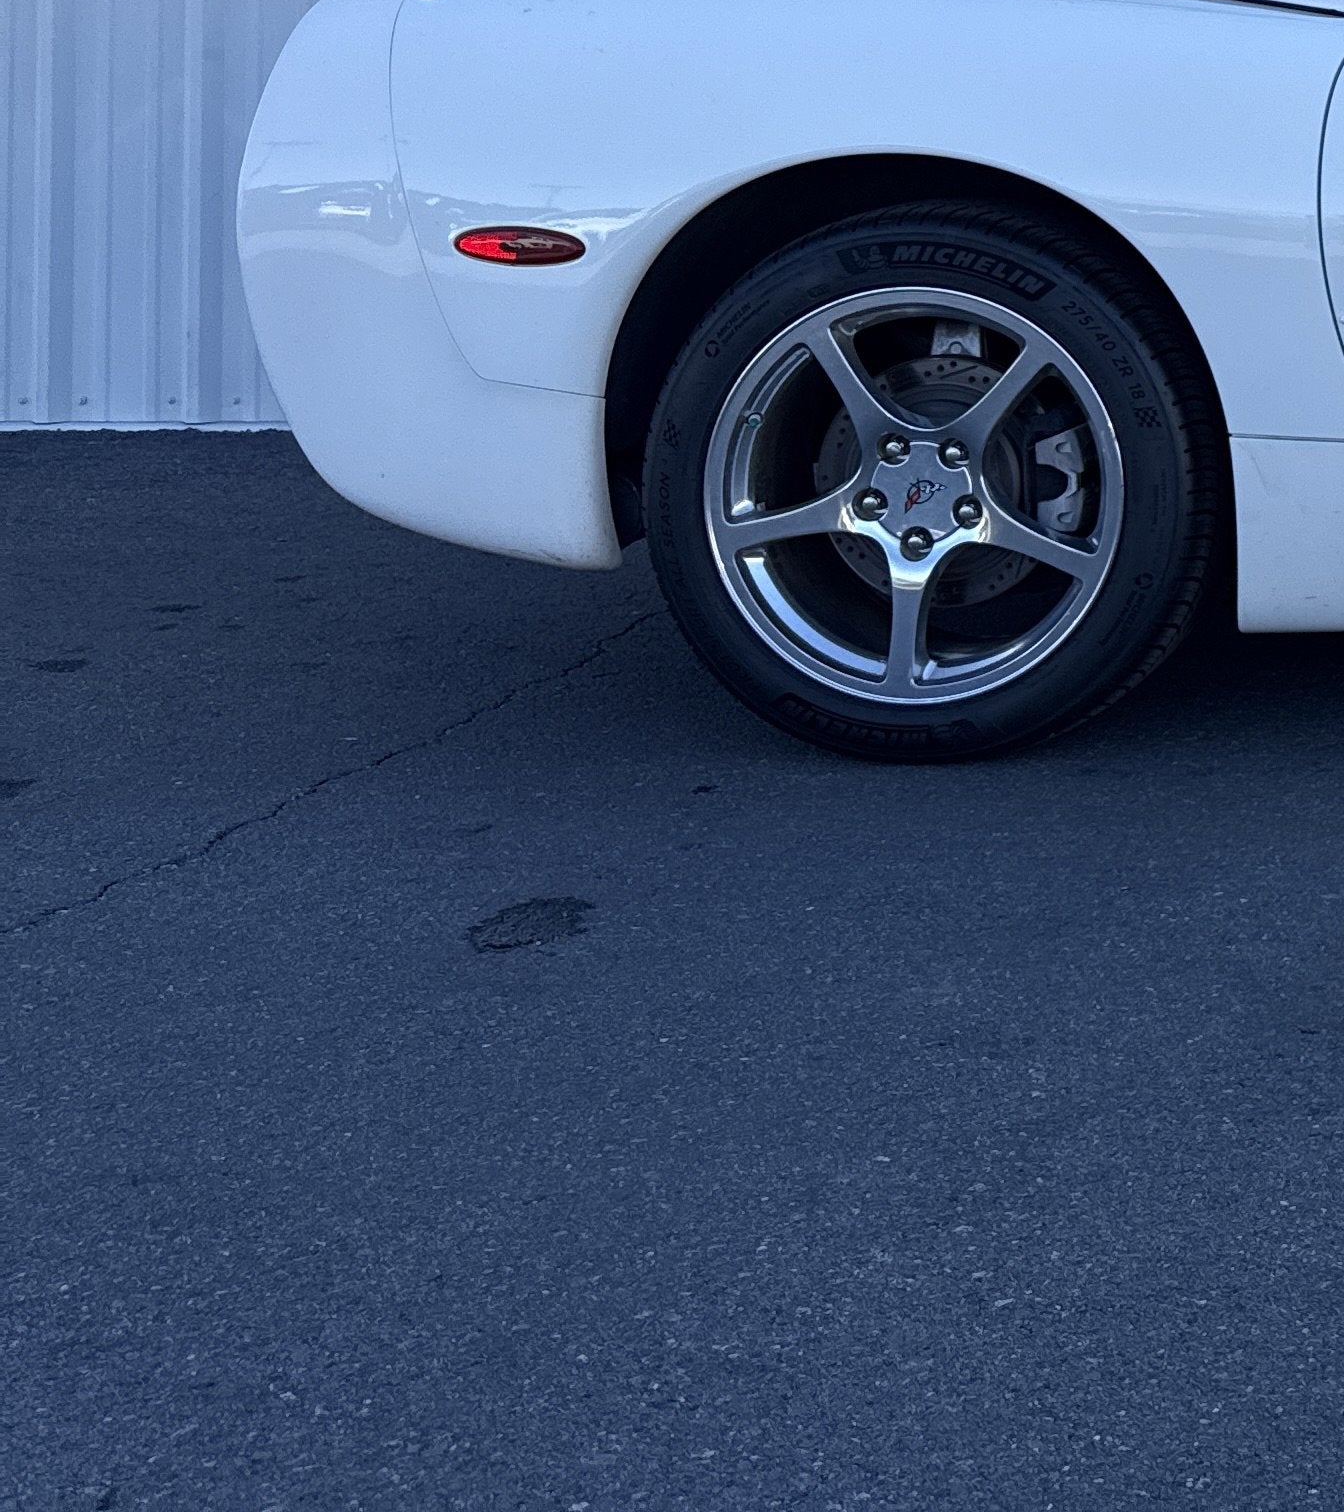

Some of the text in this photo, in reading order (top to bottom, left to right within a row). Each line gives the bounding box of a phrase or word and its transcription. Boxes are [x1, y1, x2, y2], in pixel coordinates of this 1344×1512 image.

[892, 245, 1045, 295] MICHELIN
[1061, 300, 1146, 400] 275/40 ZR 18
[659, 470, 676, 549] SEASON
